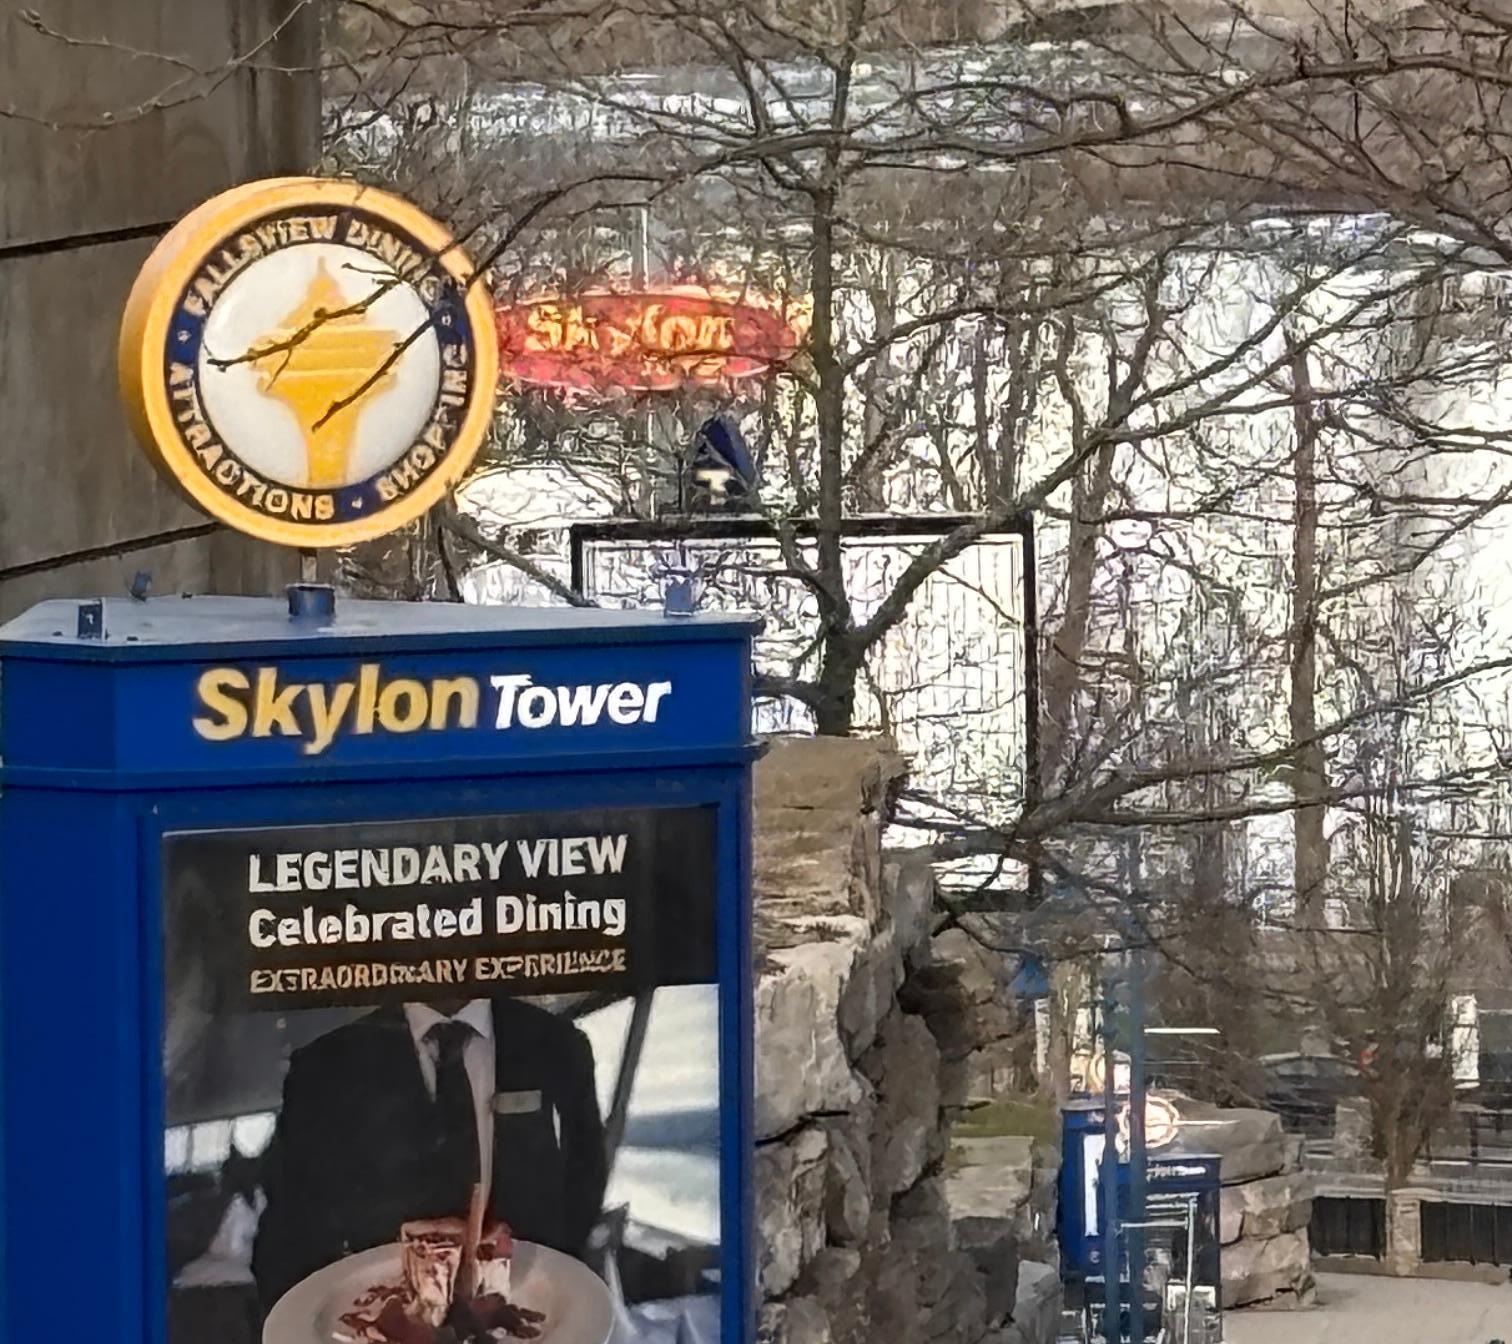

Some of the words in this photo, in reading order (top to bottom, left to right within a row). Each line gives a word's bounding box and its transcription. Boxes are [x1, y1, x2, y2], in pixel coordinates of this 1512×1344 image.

[183, 215, 338, 316] FALLSVIEW
[168, 360, 336, 520] ATTRACTIONS
[192, 662, 481, 755] Skylon
[489, 673, 673, 731] Tower
[248, 839, 510, 894] LEGENDARY
[517, 833, 630, 878] VIEW
[248, 896, 483, 949] Celebrated
[496, 889, 628, 937] Dining
